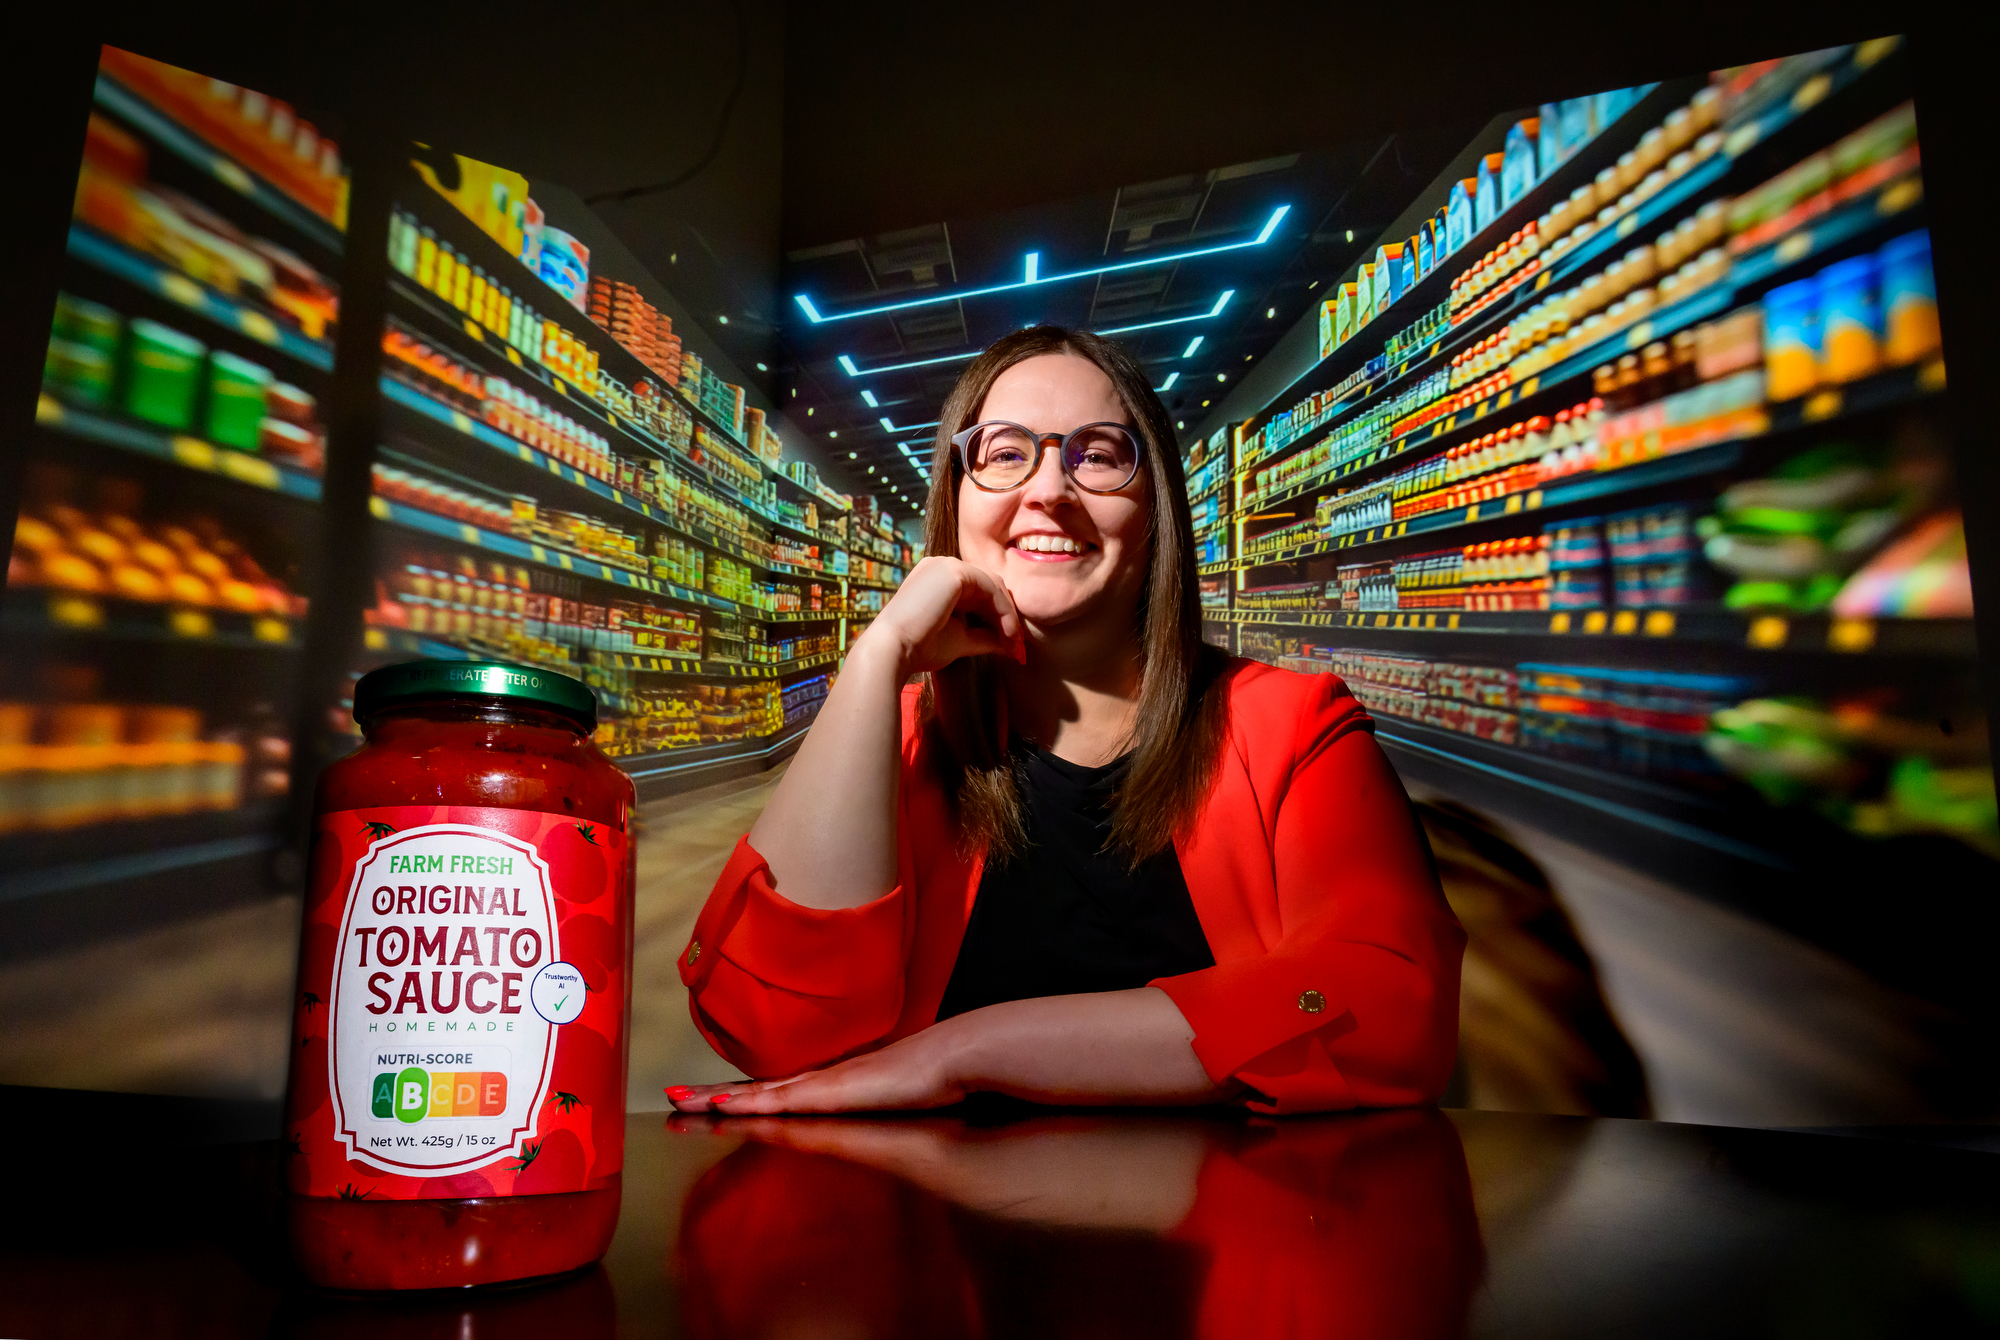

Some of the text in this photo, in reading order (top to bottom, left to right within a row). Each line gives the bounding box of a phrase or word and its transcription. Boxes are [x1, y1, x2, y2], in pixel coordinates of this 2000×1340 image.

[390, 855, 513, 875] FARM FRESH
[372, 885, 527, 916] ORIGINAL
[355, 925, 542, 968] TOMATO
[544, 973, 578, 983] Trustworthy
[365, 971, 523, 1015] SAUCE
[368, 1022, 513, 1033] HOMEMADE
[378, 1054, 472, 1065] NUTRI-SCORE
[371, 1137, 392, 1147] Net
[396, 1137, 417, 1146] Wt.
[422, 1136, 453, 1148] 425g
[466, 1135, 478, 1145] 15
[481, 1137, 496, 1145] oz
